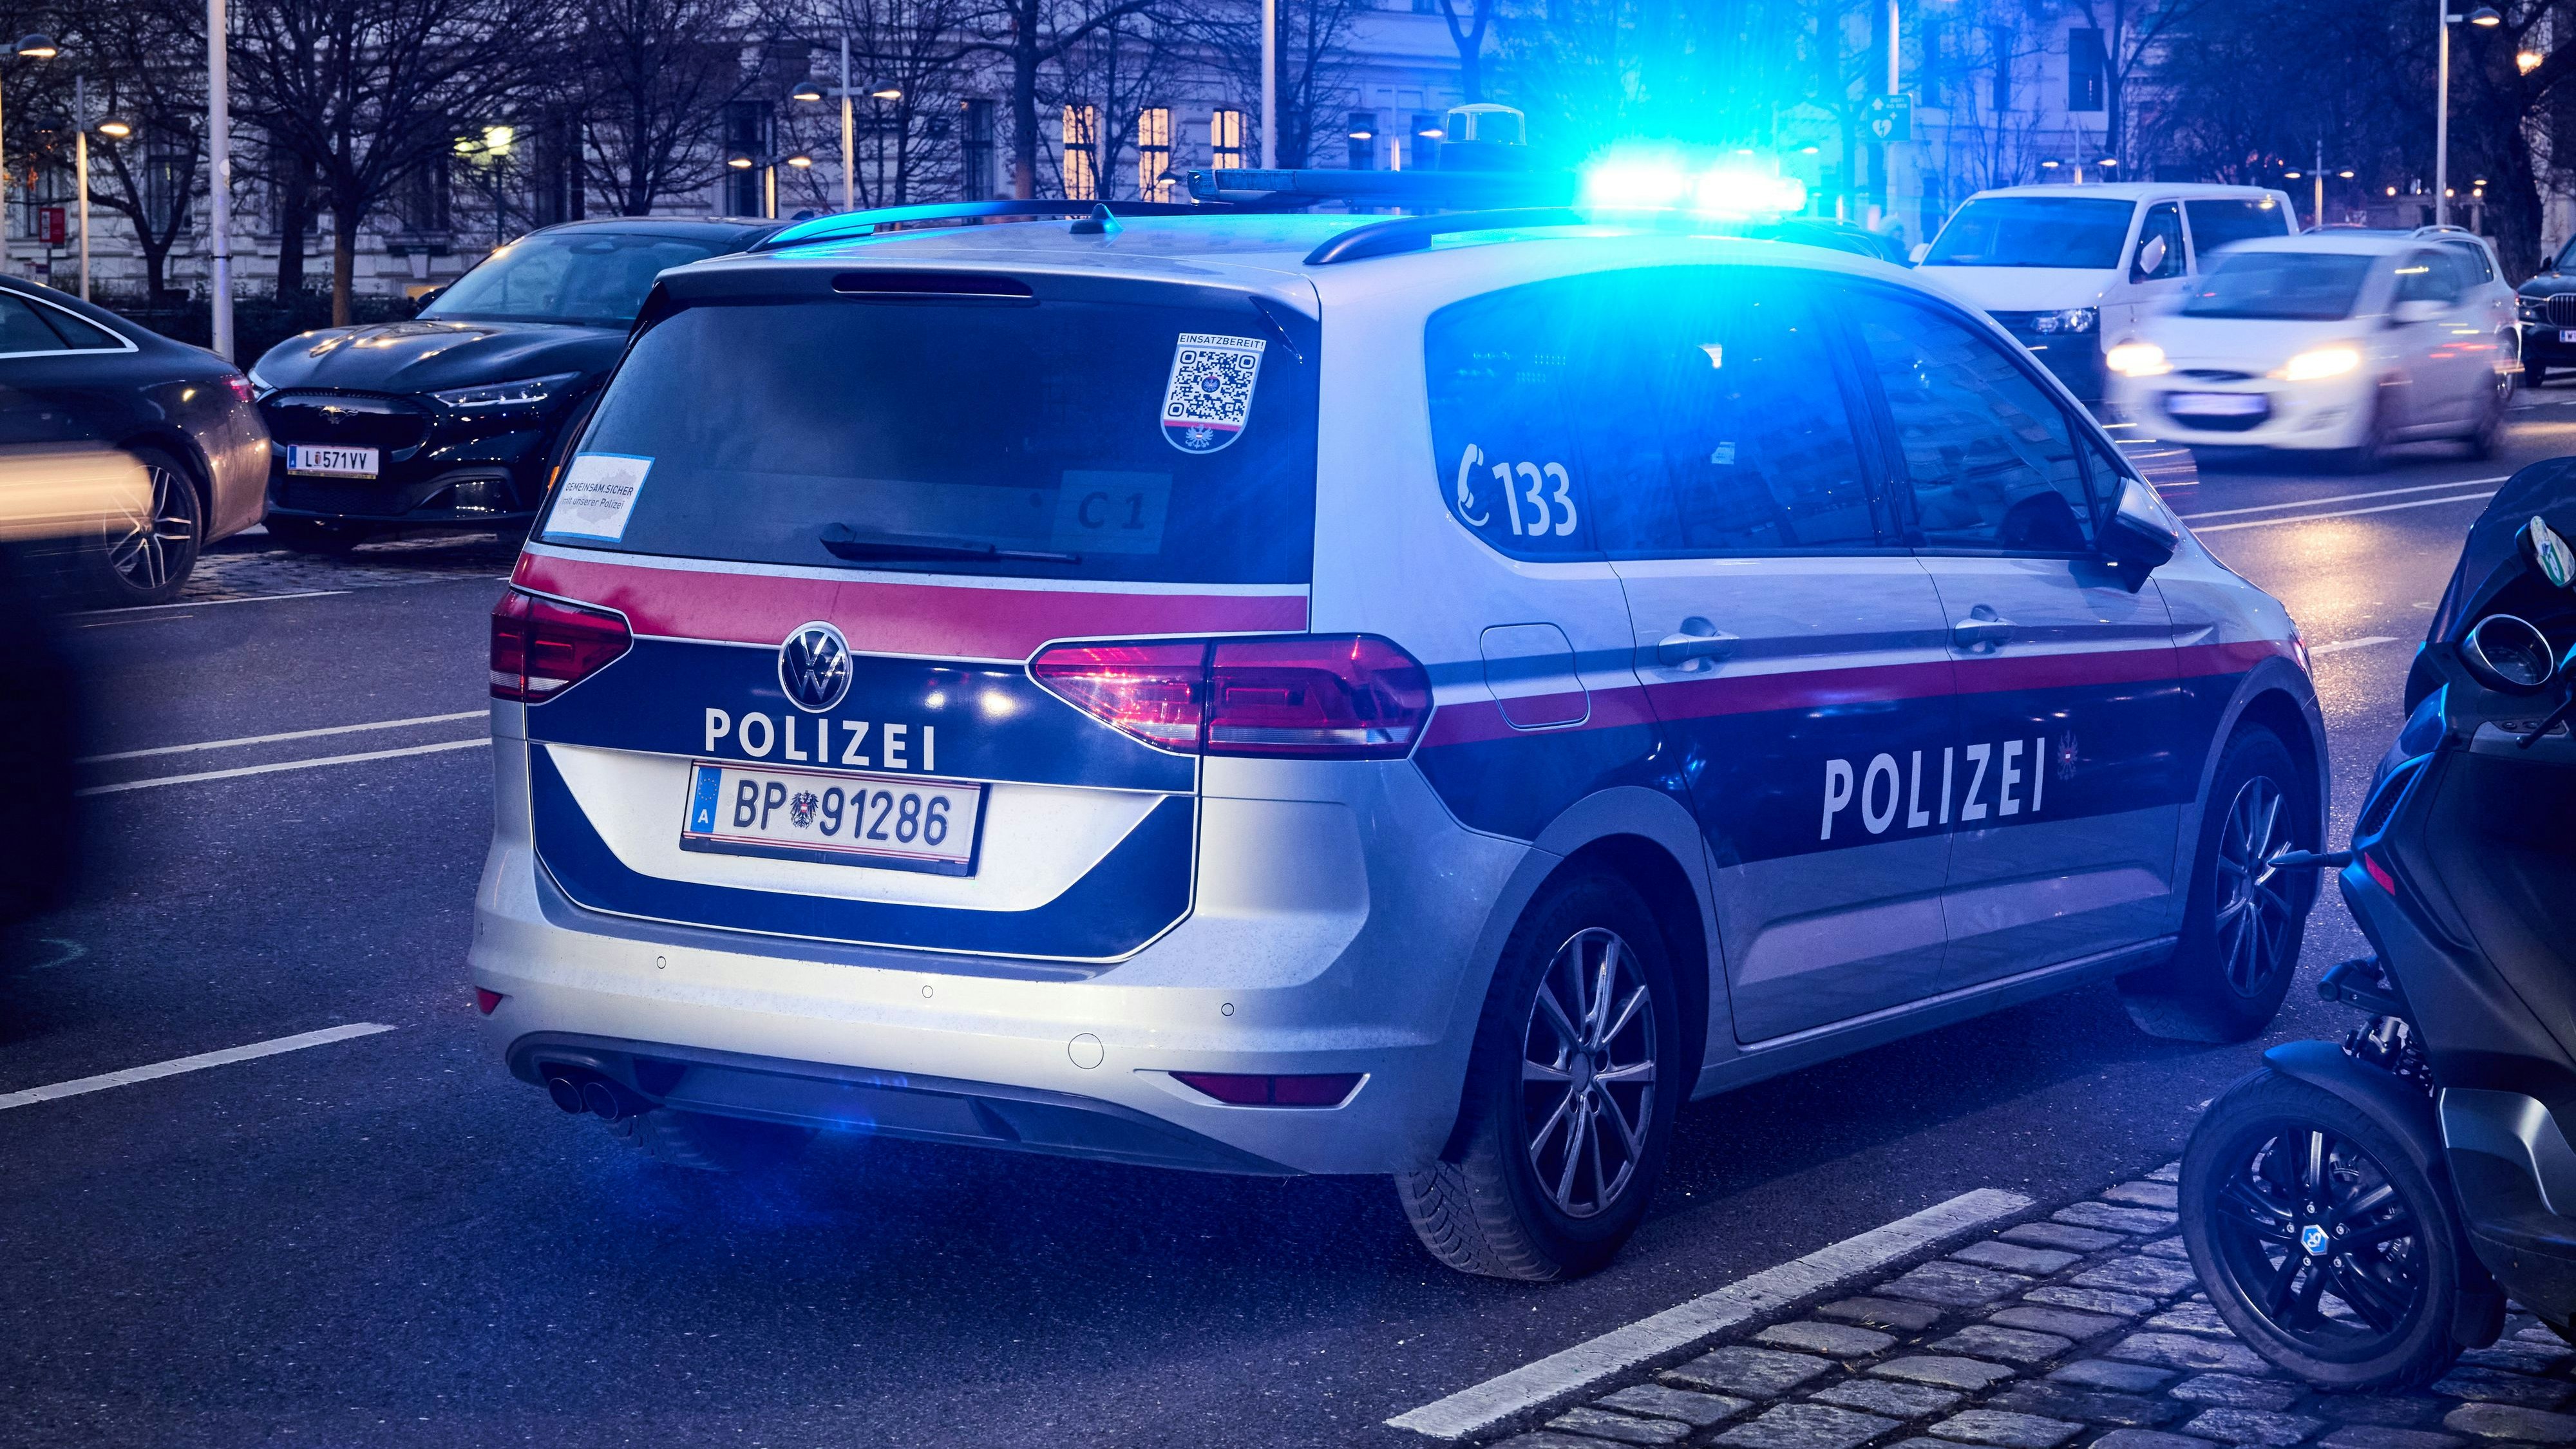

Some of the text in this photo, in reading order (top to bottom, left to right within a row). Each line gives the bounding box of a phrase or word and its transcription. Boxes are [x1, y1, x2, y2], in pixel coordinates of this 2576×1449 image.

[1179, 334, 1264, 349] EINSATZBEREIT!
[565, 482, 634, 497] GEMEINSAM.SICHER
[573, 498, 600, 507] unserer
[599, 498, 625, 510] Polizei
[1492, 461, 1577, 536] 133
[1078, 491, 1144, 530] C 1
[706, 707, 934, 771] POLIZEI
[1821, 737, 2045, 841] POLIZEI
[697, 810, 709, 824] A
[819, 786, 951, 847] 91286
